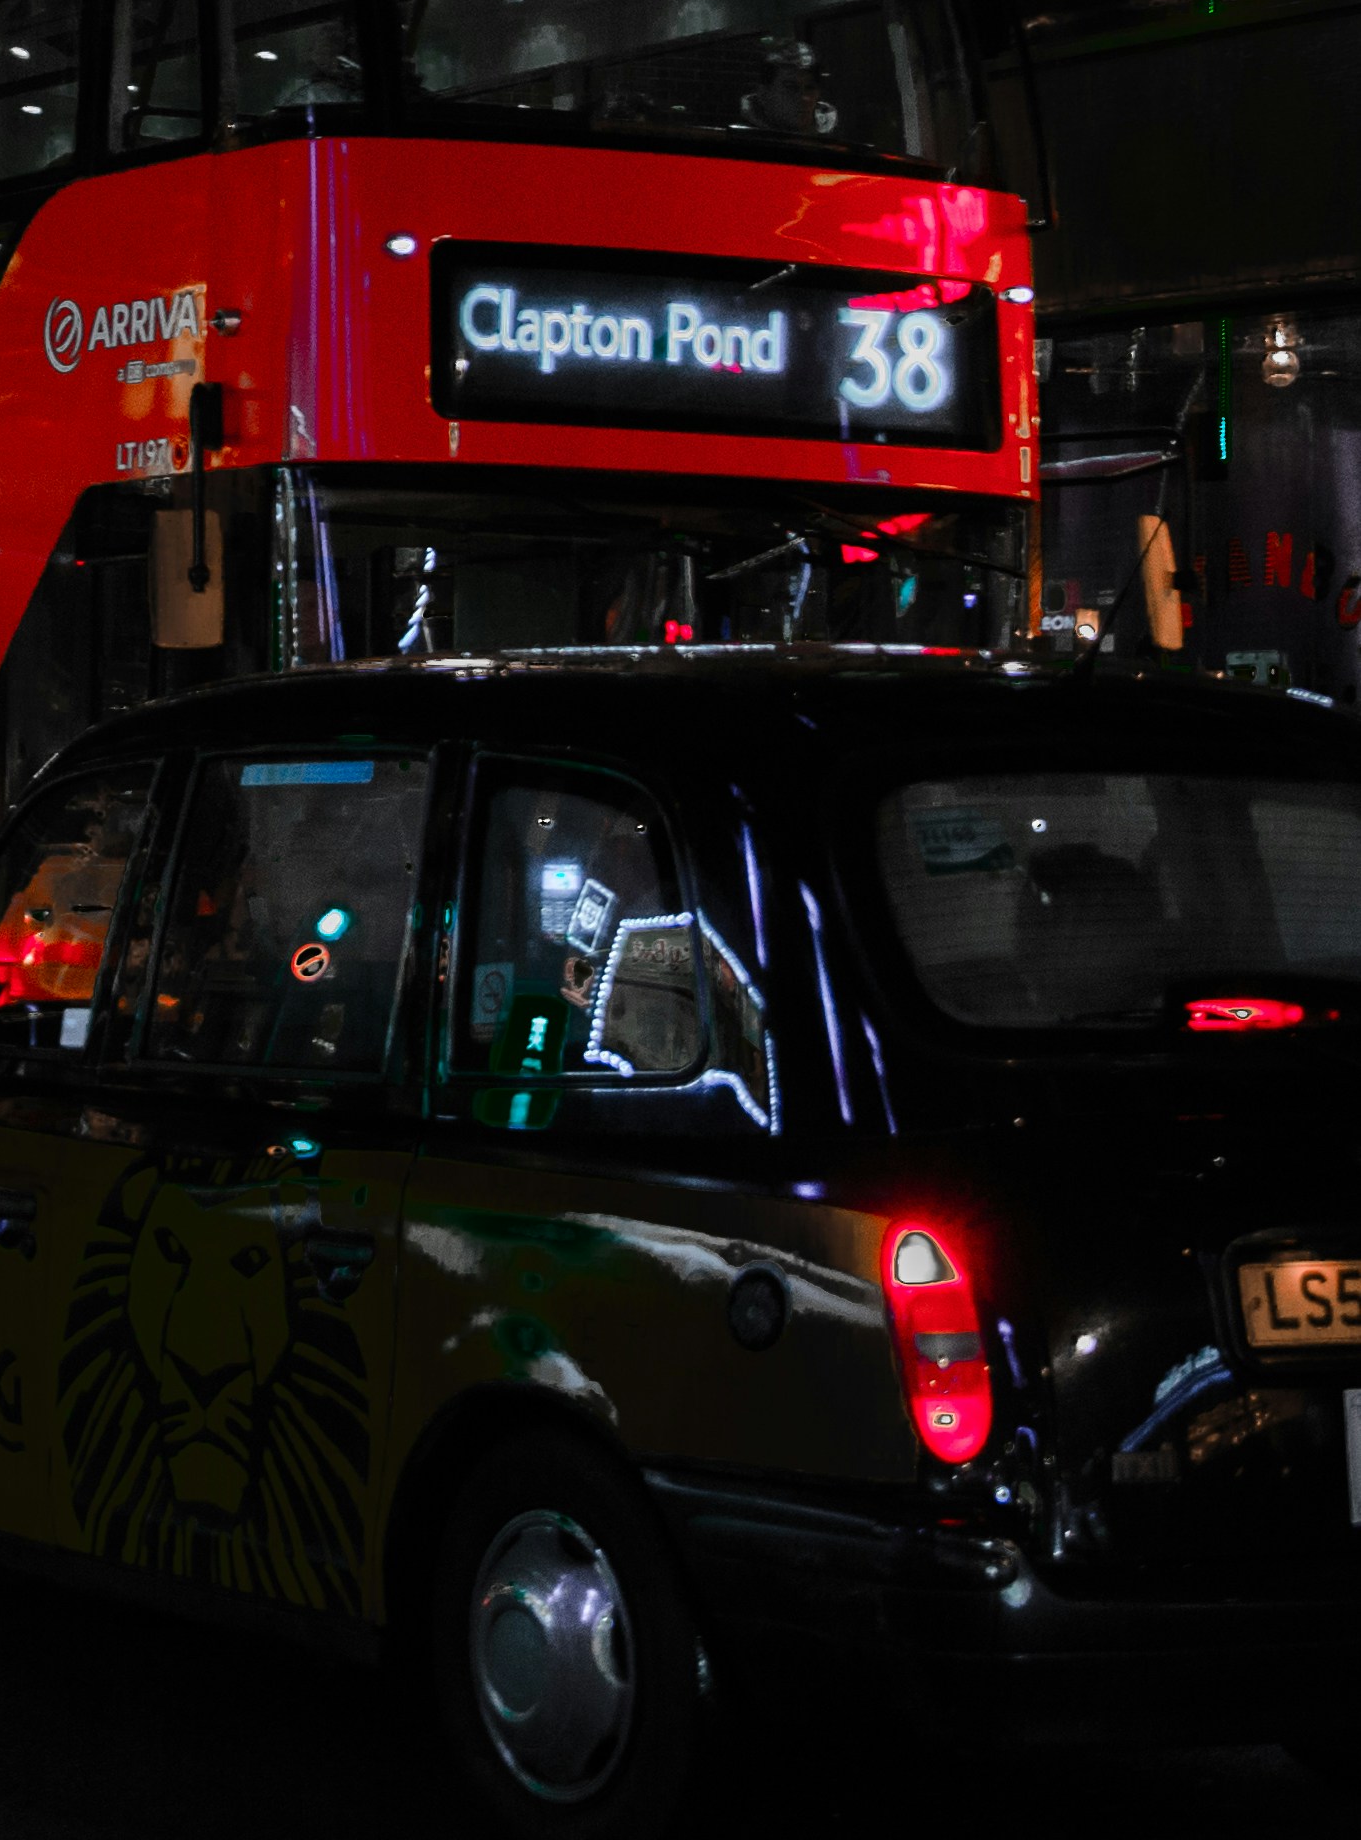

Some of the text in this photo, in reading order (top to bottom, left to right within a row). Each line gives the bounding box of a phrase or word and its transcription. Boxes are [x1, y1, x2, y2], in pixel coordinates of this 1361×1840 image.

[88, 294, 199, 351] ARRIVA
[460, 286, 784, 372] Clapton Pond
[839, 308, 948, 411] 38
[116, 438, 169, 471] LT197
